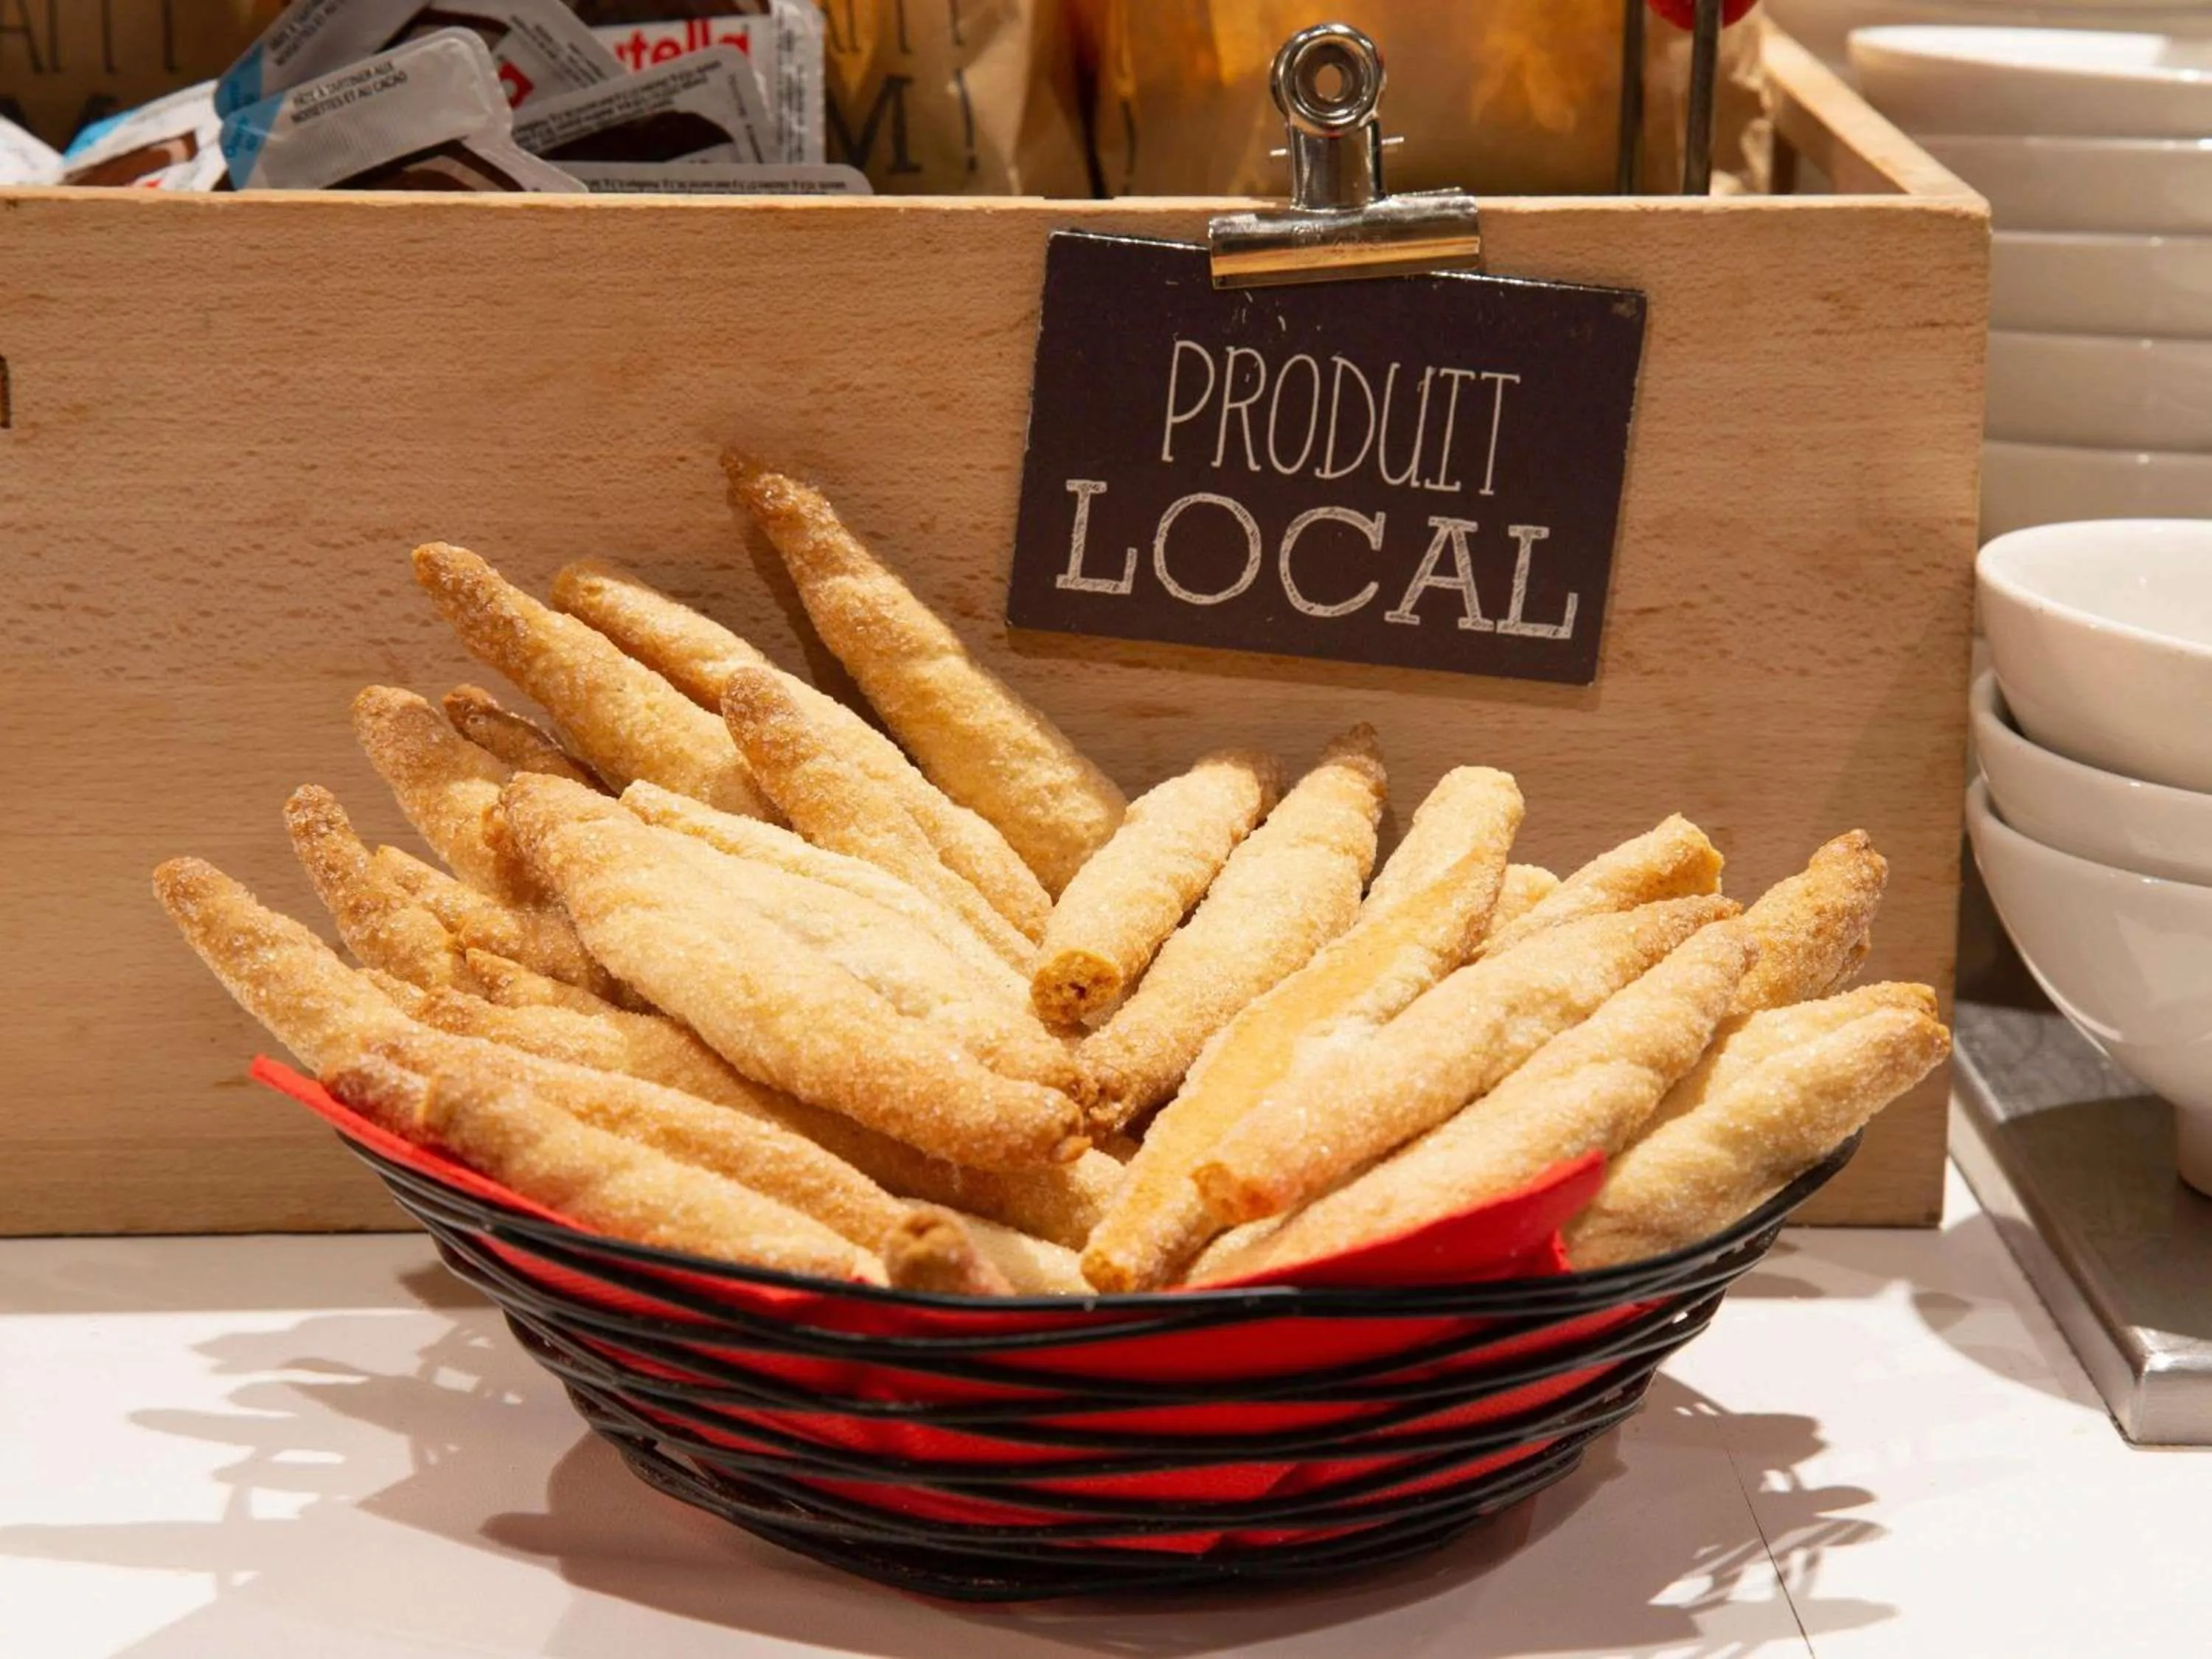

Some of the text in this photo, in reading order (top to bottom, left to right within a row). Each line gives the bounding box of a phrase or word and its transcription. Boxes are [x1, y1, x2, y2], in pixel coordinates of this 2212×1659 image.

[614, 18, 749, 72] tella
[1162, 339, 1520, 495] PRODUIT
[1056, 479, 1578, 639] LOCAL
